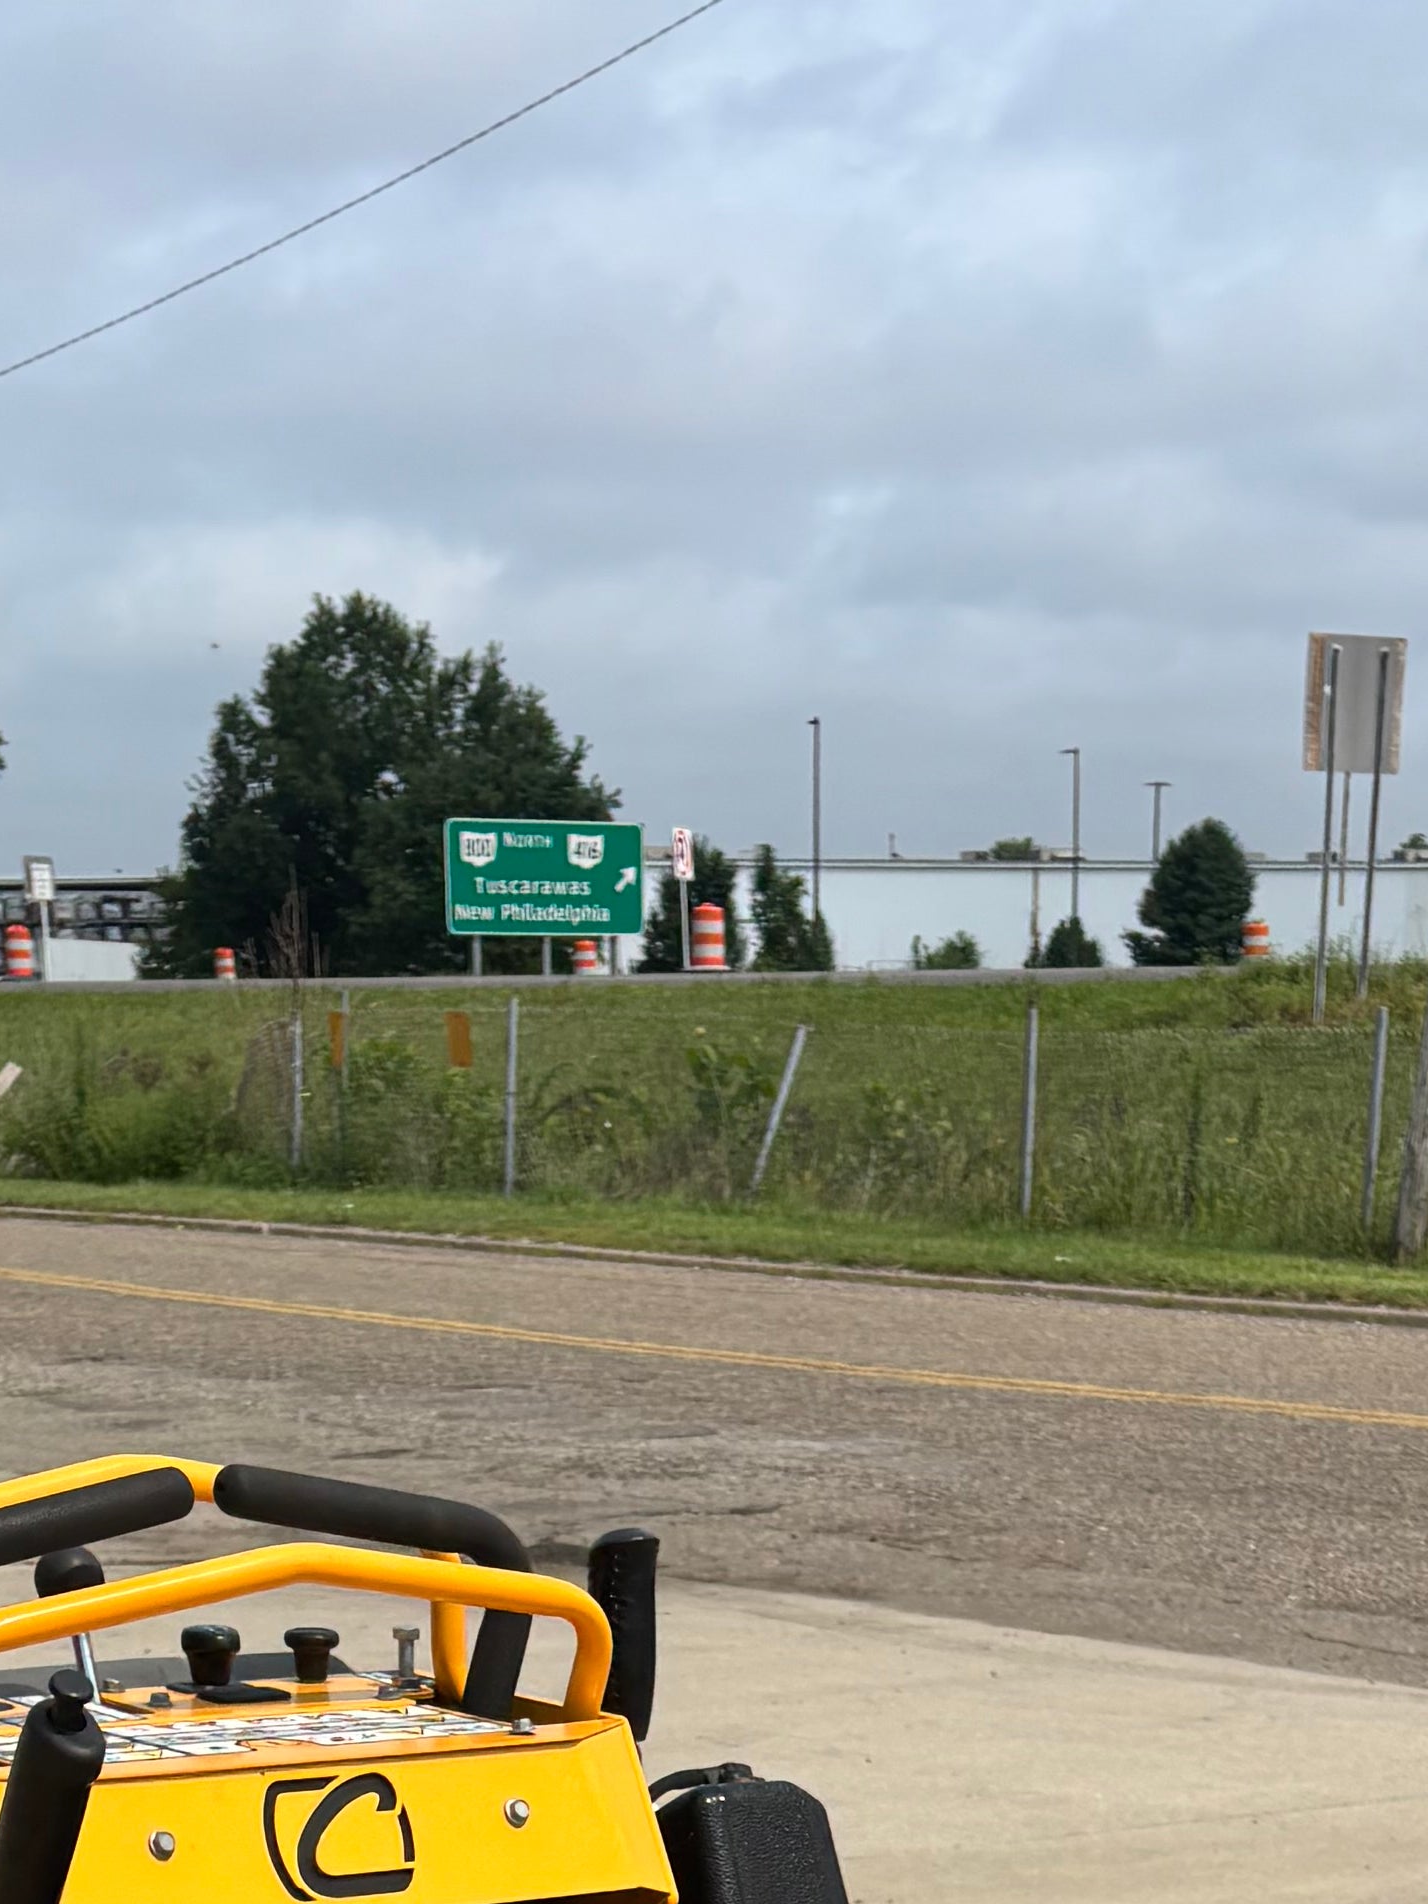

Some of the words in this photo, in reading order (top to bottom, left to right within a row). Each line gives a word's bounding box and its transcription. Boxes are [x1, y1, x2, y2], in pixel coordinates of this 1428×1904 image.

[474, 876, 591, 896] Tuscarawas
[454, 903, 494, 921] New
[501, 903, 611, 926] Philadelphia
